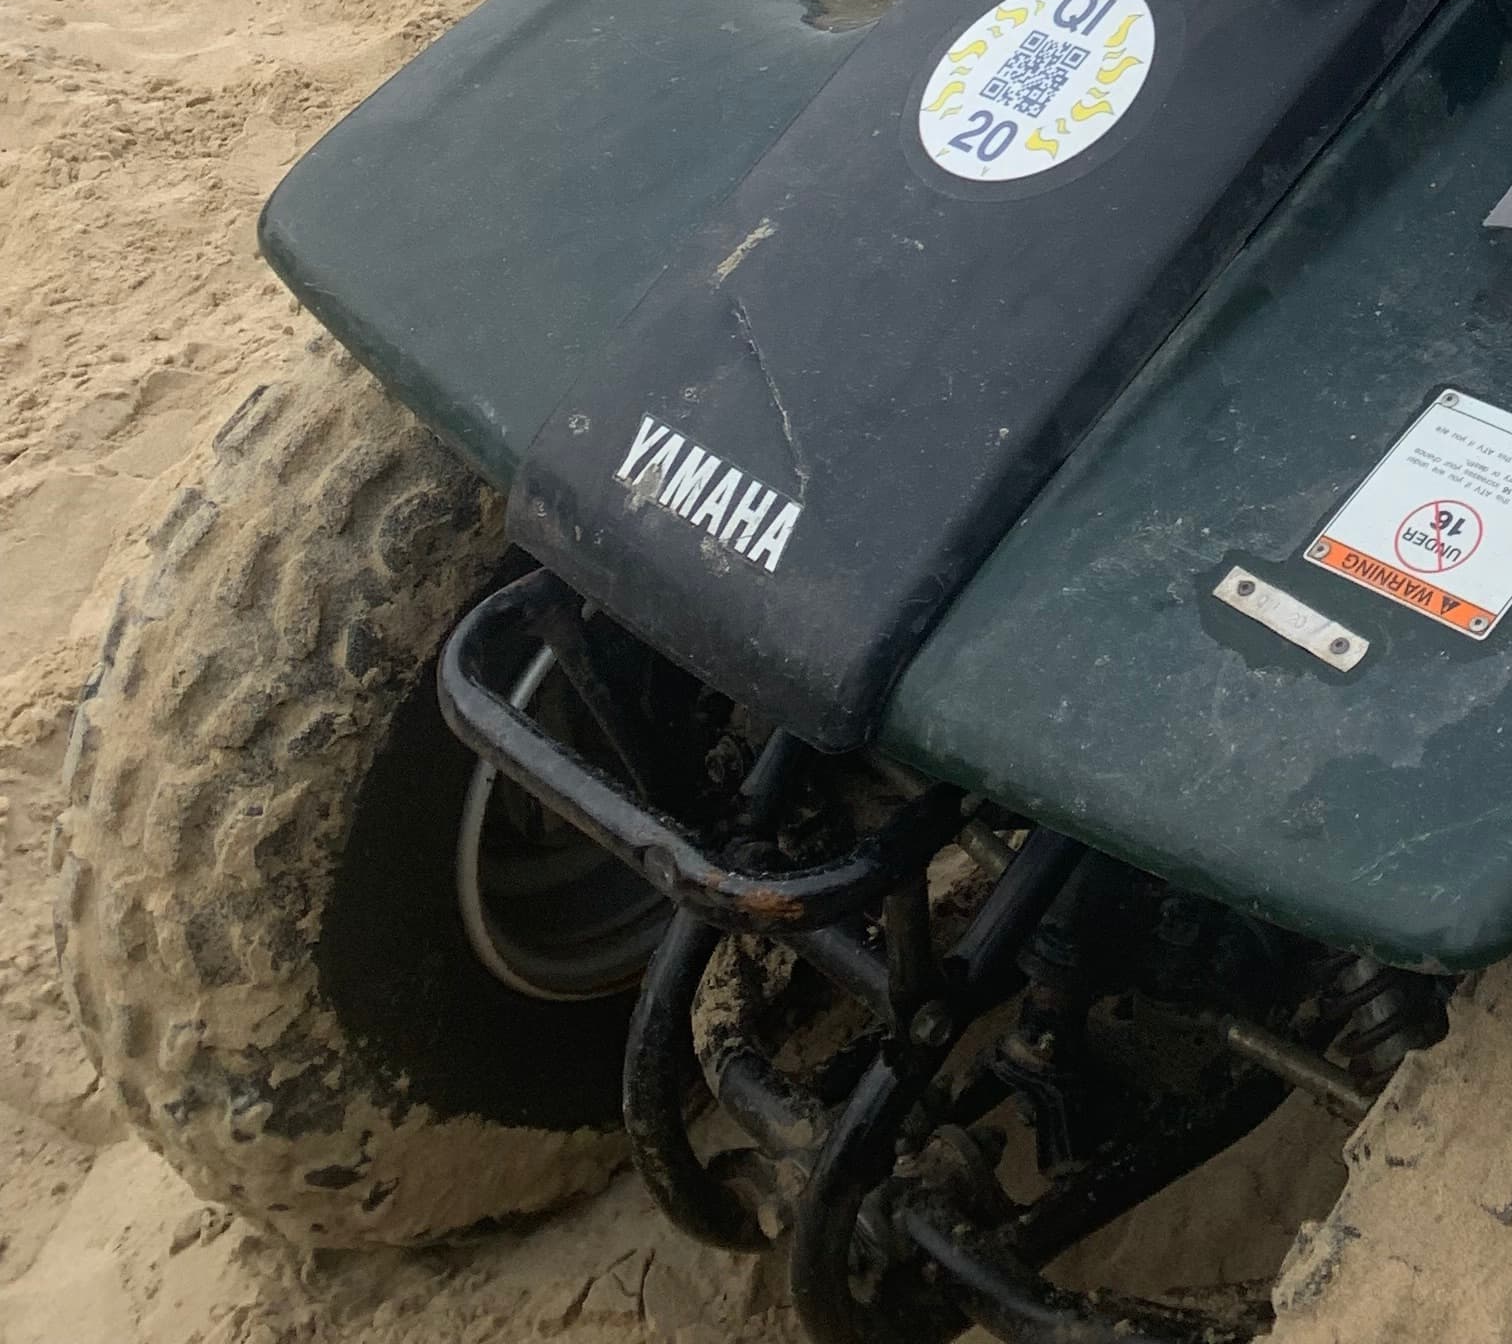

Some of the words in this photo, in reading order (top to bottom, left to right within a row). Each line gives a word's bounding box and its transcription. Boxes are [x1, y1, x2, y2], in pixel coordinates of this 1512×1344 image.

[947, 110, 1019, 162] 20
[614, 416, 803, 574] YAMAHA
[1400, 526, 1463, 562] UNDER
[1426, 507, 1471, 539] 16
[1338, 551, 1436, 606] WARNING
